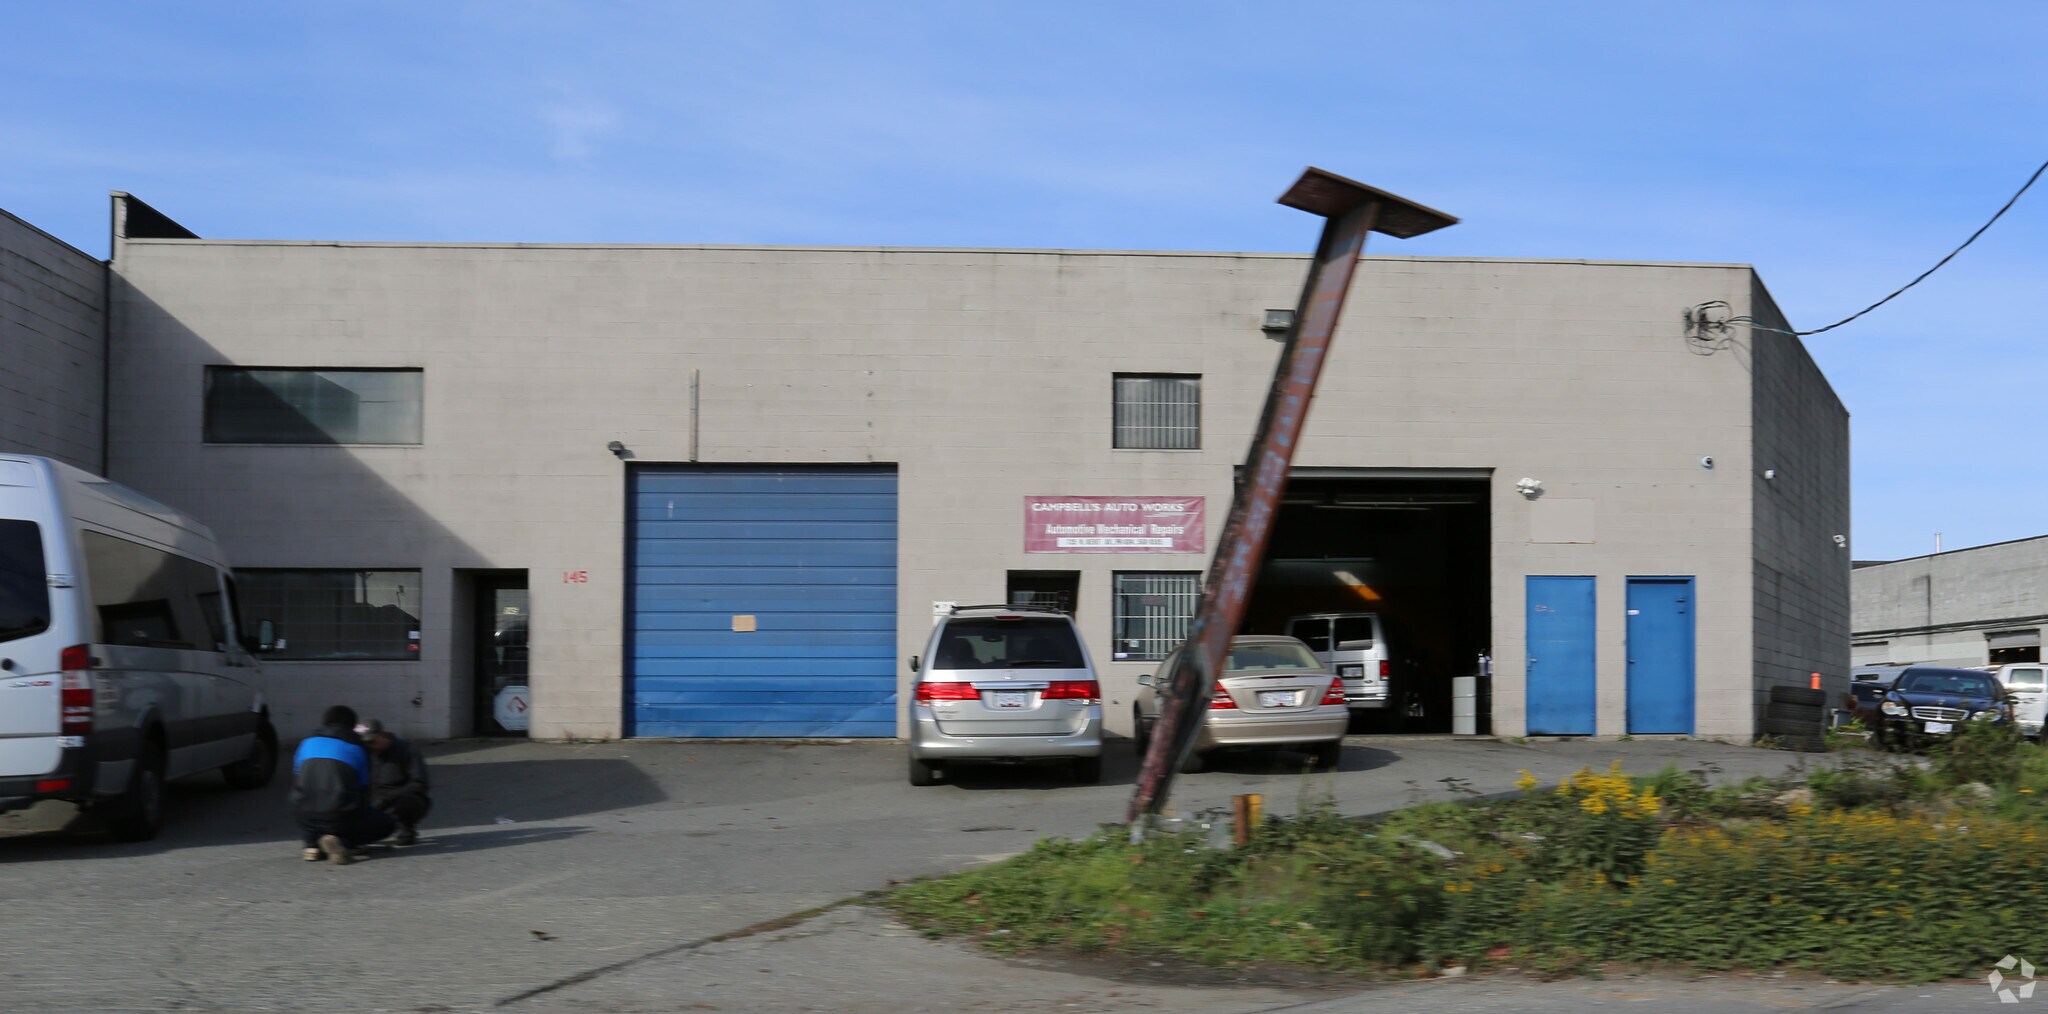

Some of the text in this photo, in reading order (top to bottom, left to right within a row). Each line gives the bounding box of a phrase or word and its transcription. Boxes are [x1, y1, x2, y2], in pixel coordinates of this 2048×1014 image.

[1104, 503, 1138, 512] AUTO
[1140, 503, 1184, 512] WORKS
[1045, 524, 1184, 536] Automotive Mechanical Repairs
[563, 570, 589, 583] 145
